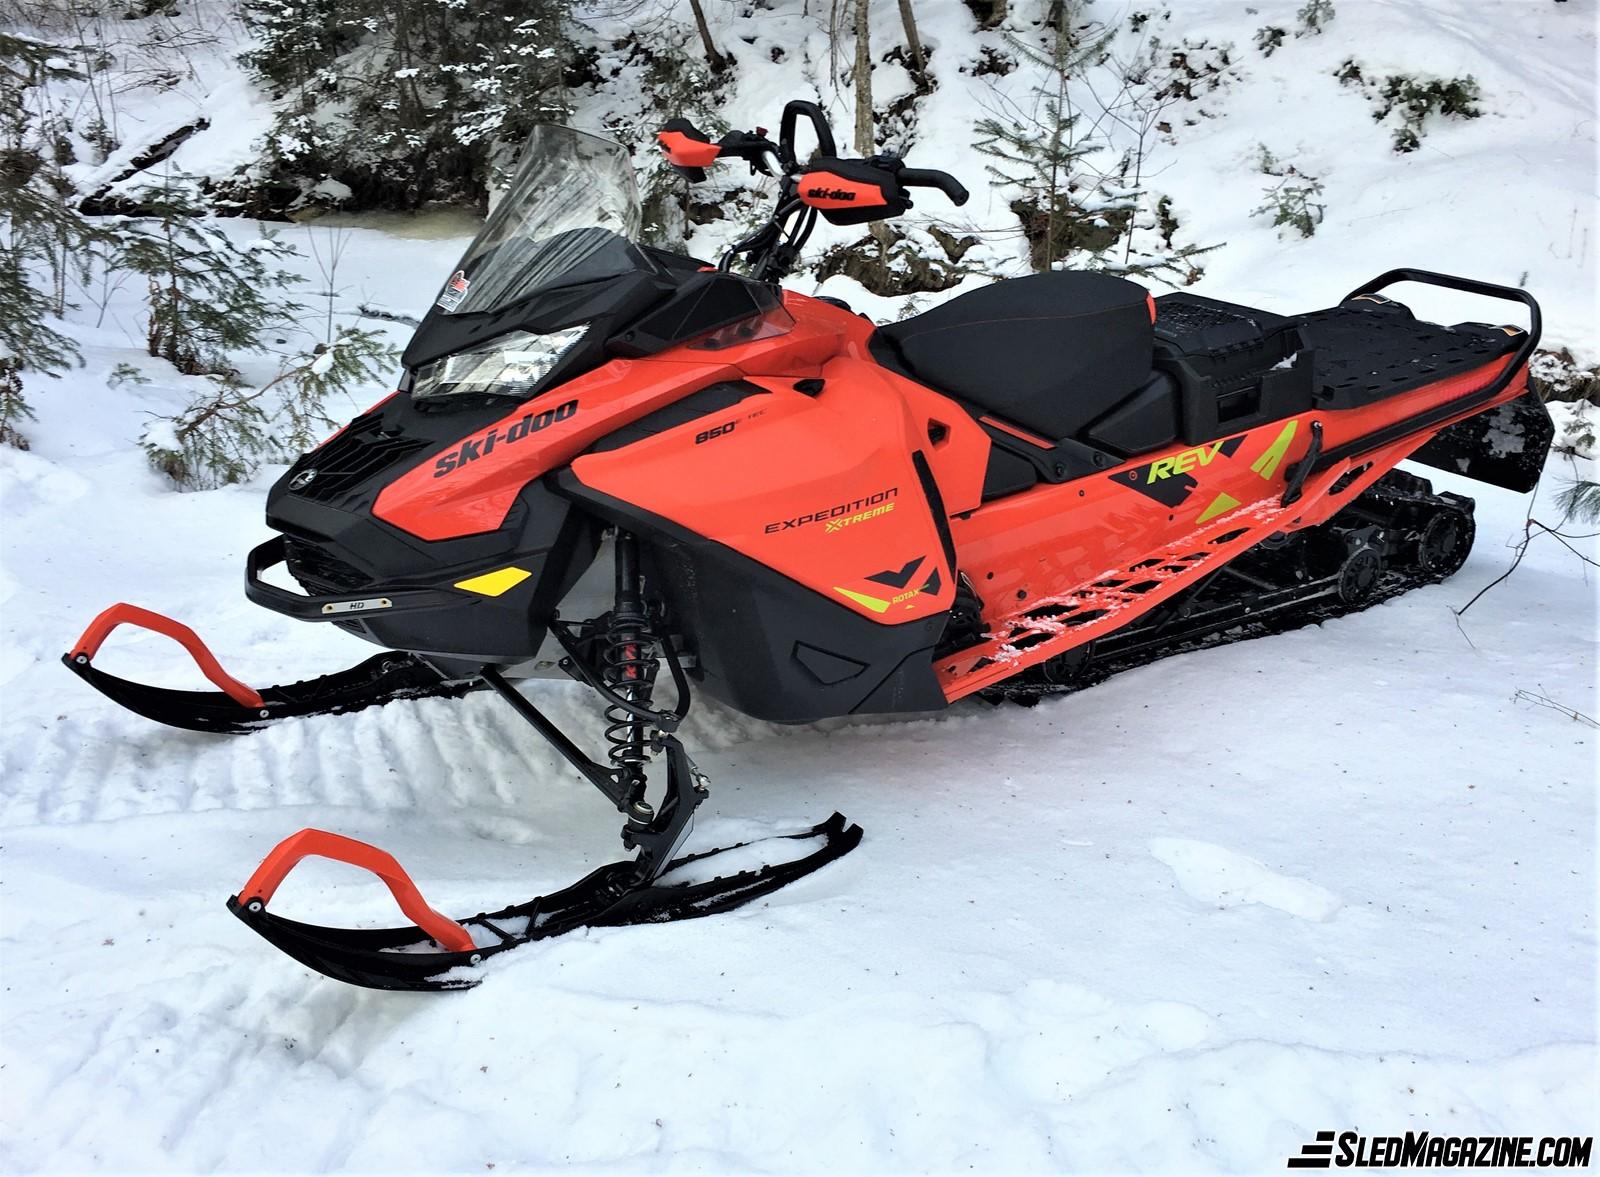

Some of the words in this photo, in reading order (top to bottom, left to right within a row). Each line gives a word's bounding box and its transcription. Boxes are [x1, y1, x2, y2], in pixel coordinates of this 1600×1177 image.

[807, 187, 856, 201] ski-doo
[433, 399, 579, 478] ski-doo
[1146, 440, 1225, 485] REV
[764, 487, 899, 534] EXPEDITION
[825, 502, 896, 533] XTREME
[892, 589, 920, 604] ROTAX
